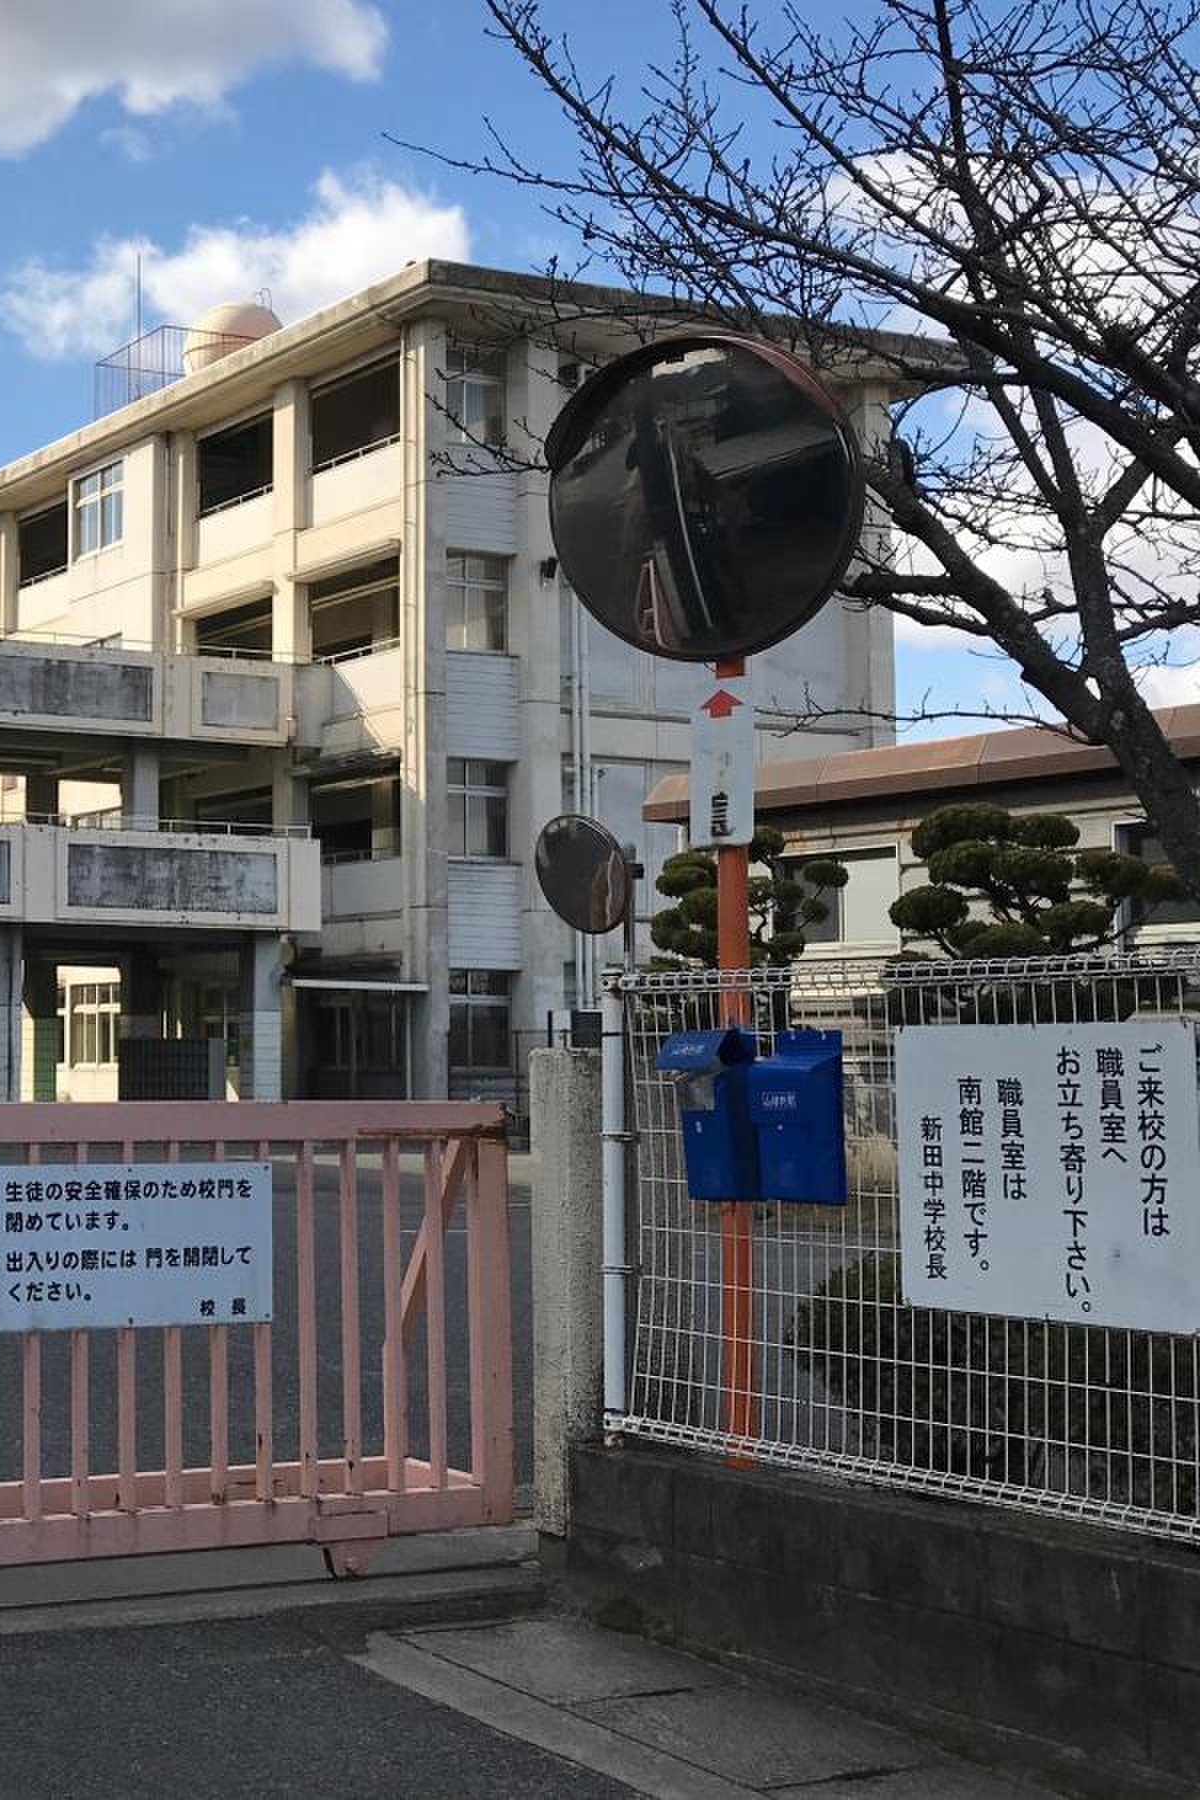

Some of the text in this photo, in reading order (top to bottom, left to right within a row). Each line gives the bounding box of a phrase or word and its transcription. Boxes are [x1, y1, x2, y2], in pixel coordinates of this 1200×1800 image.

[996, 1077, 1027, 1200] 職員室は
[1096, 1047, 1128, 1163] 職員室へ
[1137, 1043, 1170, 1237] ご来校の方は
[4, 1178, 253, 1203] 生徒の安全確保のため校門を
[5, 1210, 130, 1233] 閉めています。
[919, 1114, 948, 1281] 新田中学校長
[957, 1075, 990, 1272] 南館二階です。
[1056, 1045, 1092, 1313] お立ち寄り下さい。
[8, 1282, 92, 1302] ください。
